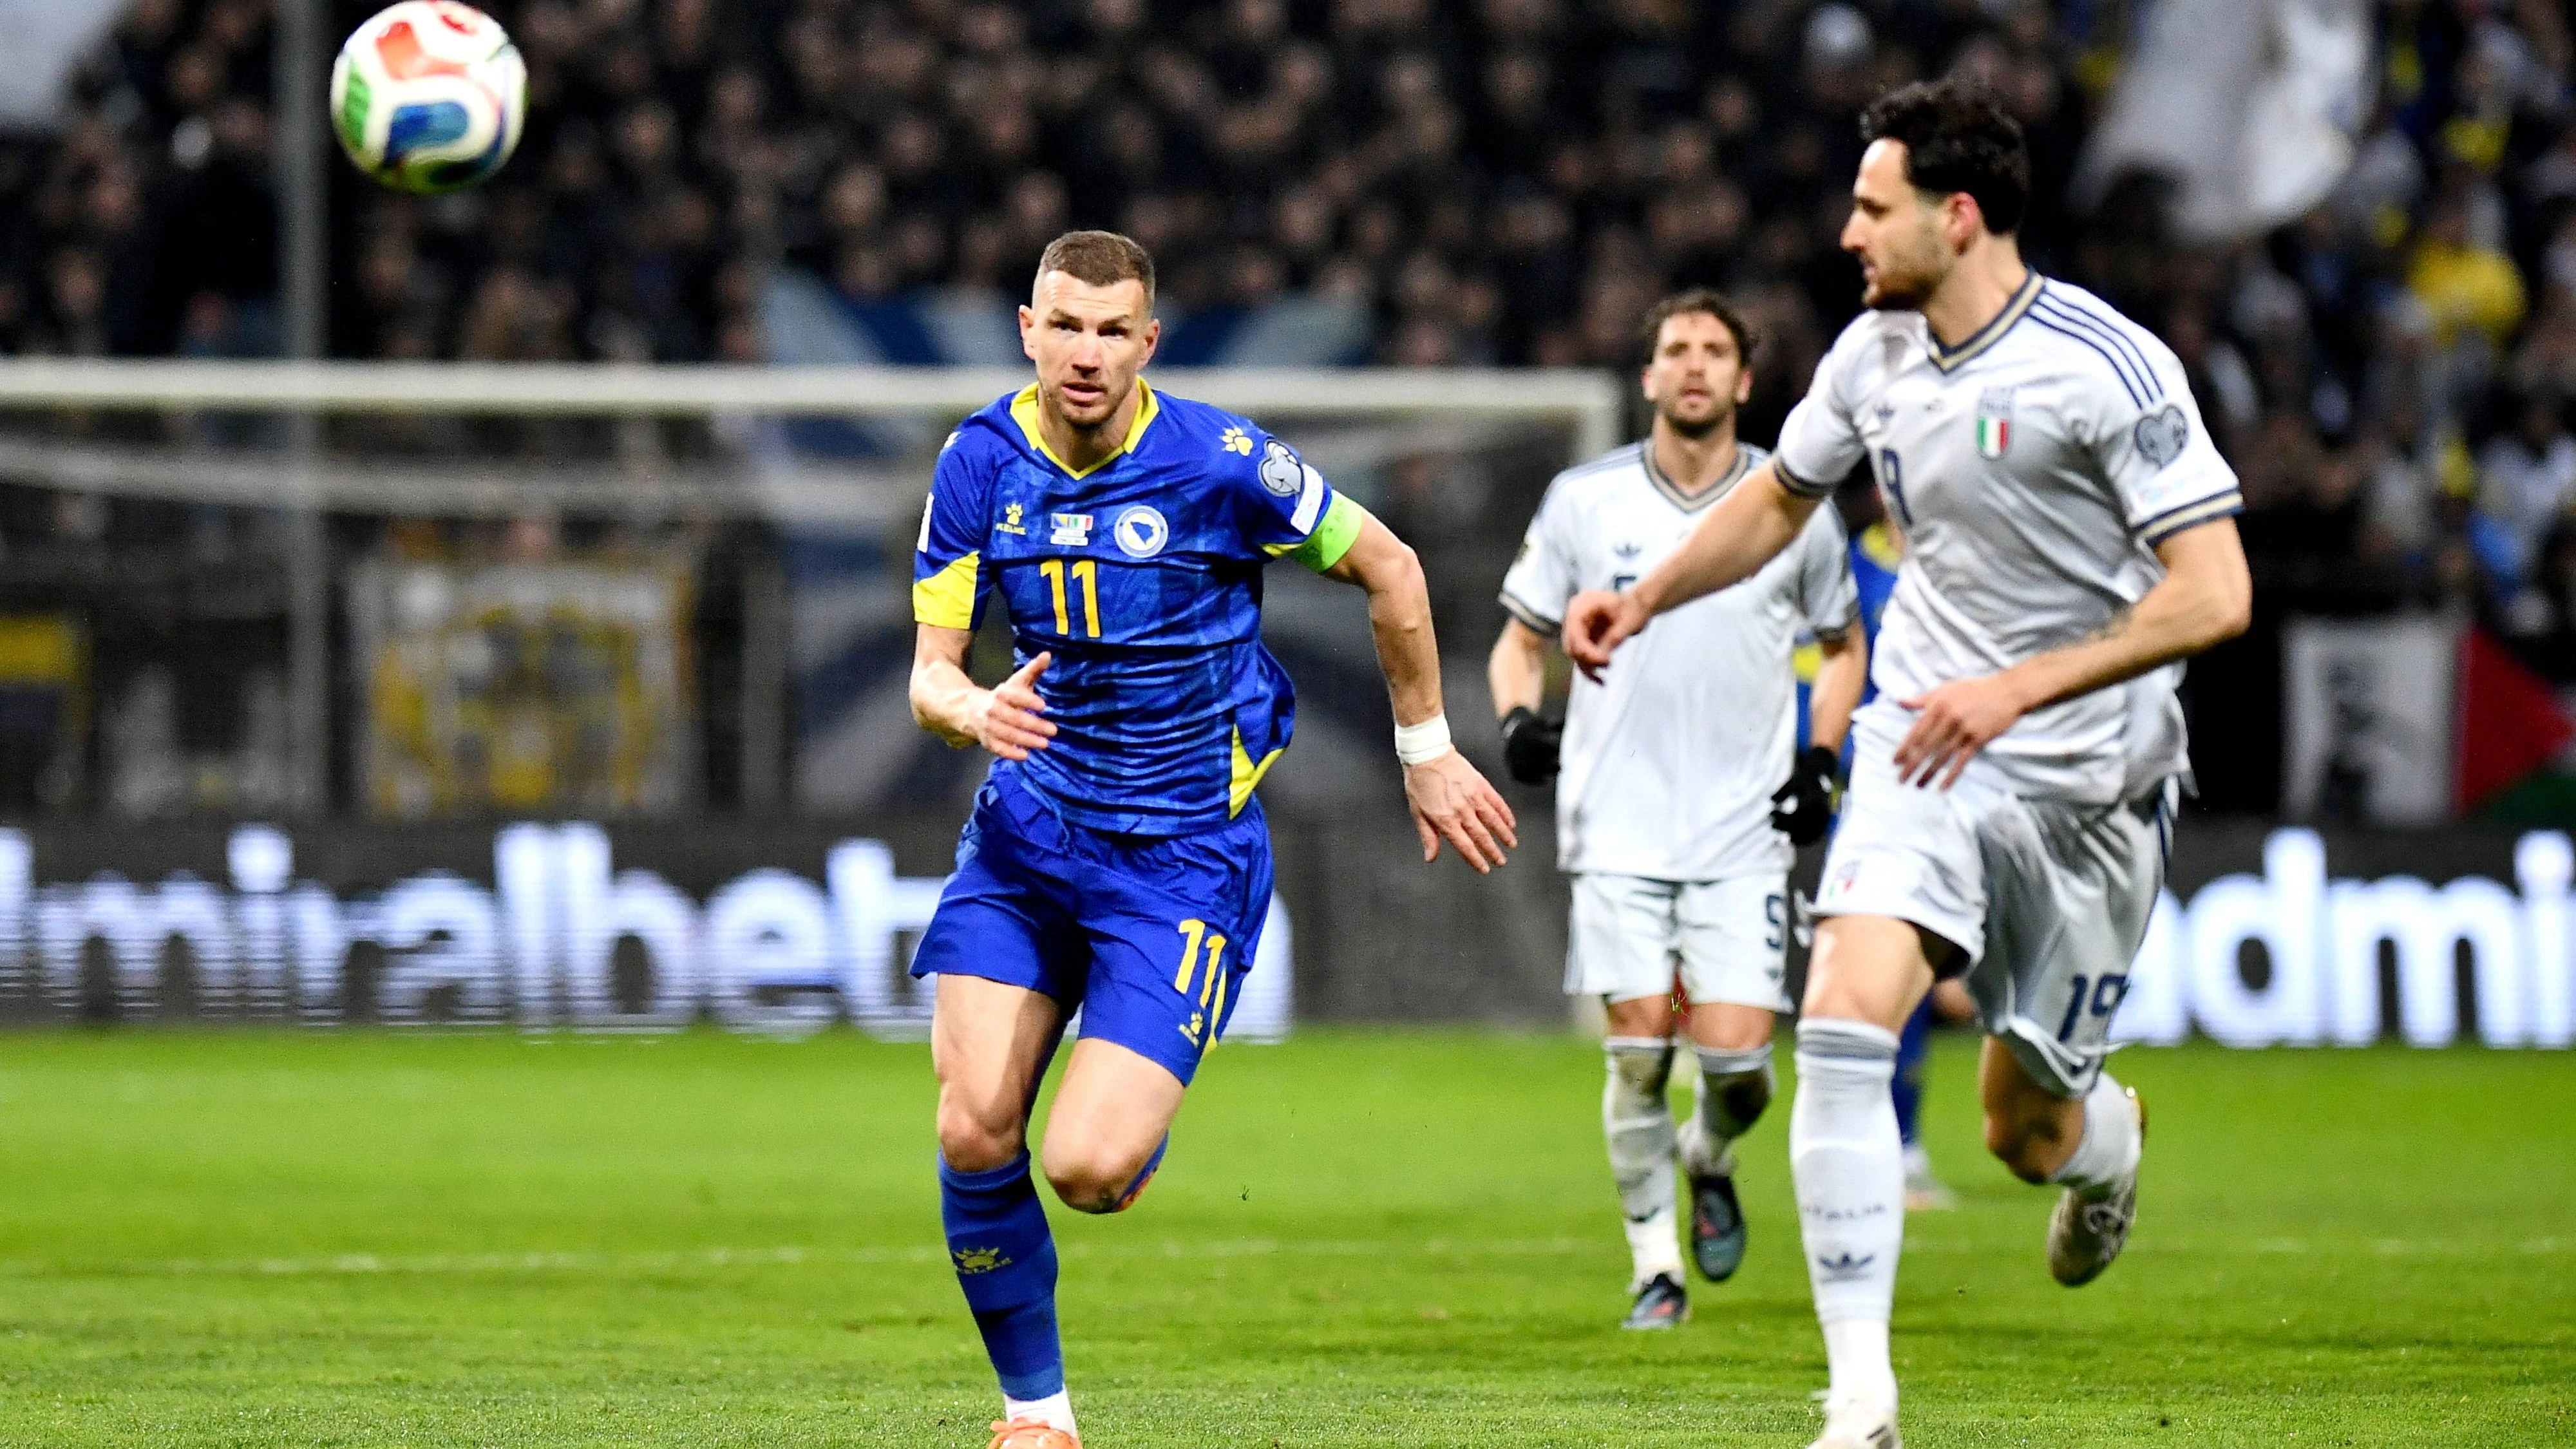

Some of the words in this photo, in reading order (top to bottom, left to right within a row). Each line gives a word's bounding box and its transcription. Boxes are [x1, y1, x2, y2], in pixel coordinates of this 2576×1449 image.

[1039, 558, 1101, 639] 11
[1174, 918, 1227, 1010] 11
[2058, 973, 2130, 1042] 19
